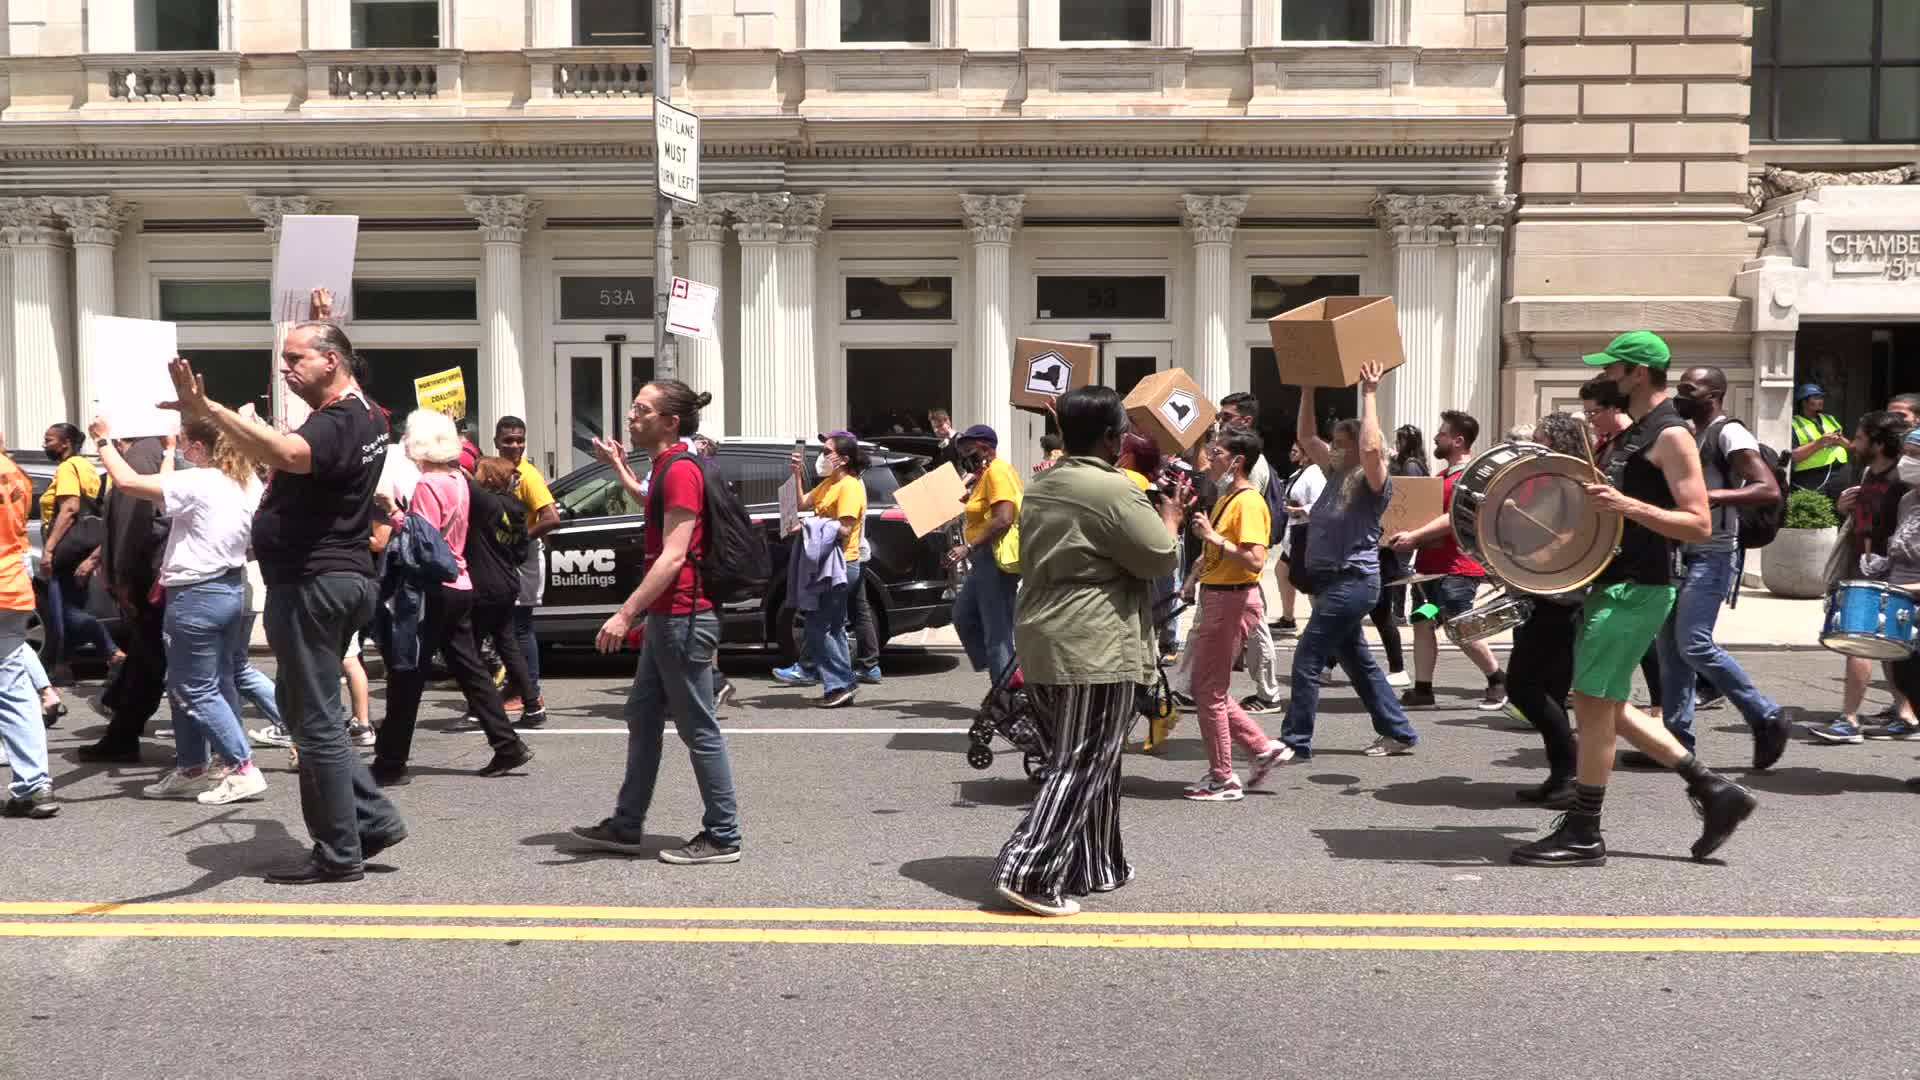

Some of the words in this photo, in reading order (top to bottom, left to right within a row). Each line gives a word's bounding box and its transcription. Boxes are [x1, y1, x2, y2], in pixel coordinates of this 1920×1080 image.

[659, 113, 672, 129] LEFT
[675, 119, 695, 140] LANE
[664, 141, 687, 163] MUST
[677, 172, 695, 192] LEFT
[1831, 234, 1920, 254] CHAMBE
[599, 289, 636, 306] 53A
[551, 549, 616, 573] NYC
[551, 574, 617, 588] Buildings
